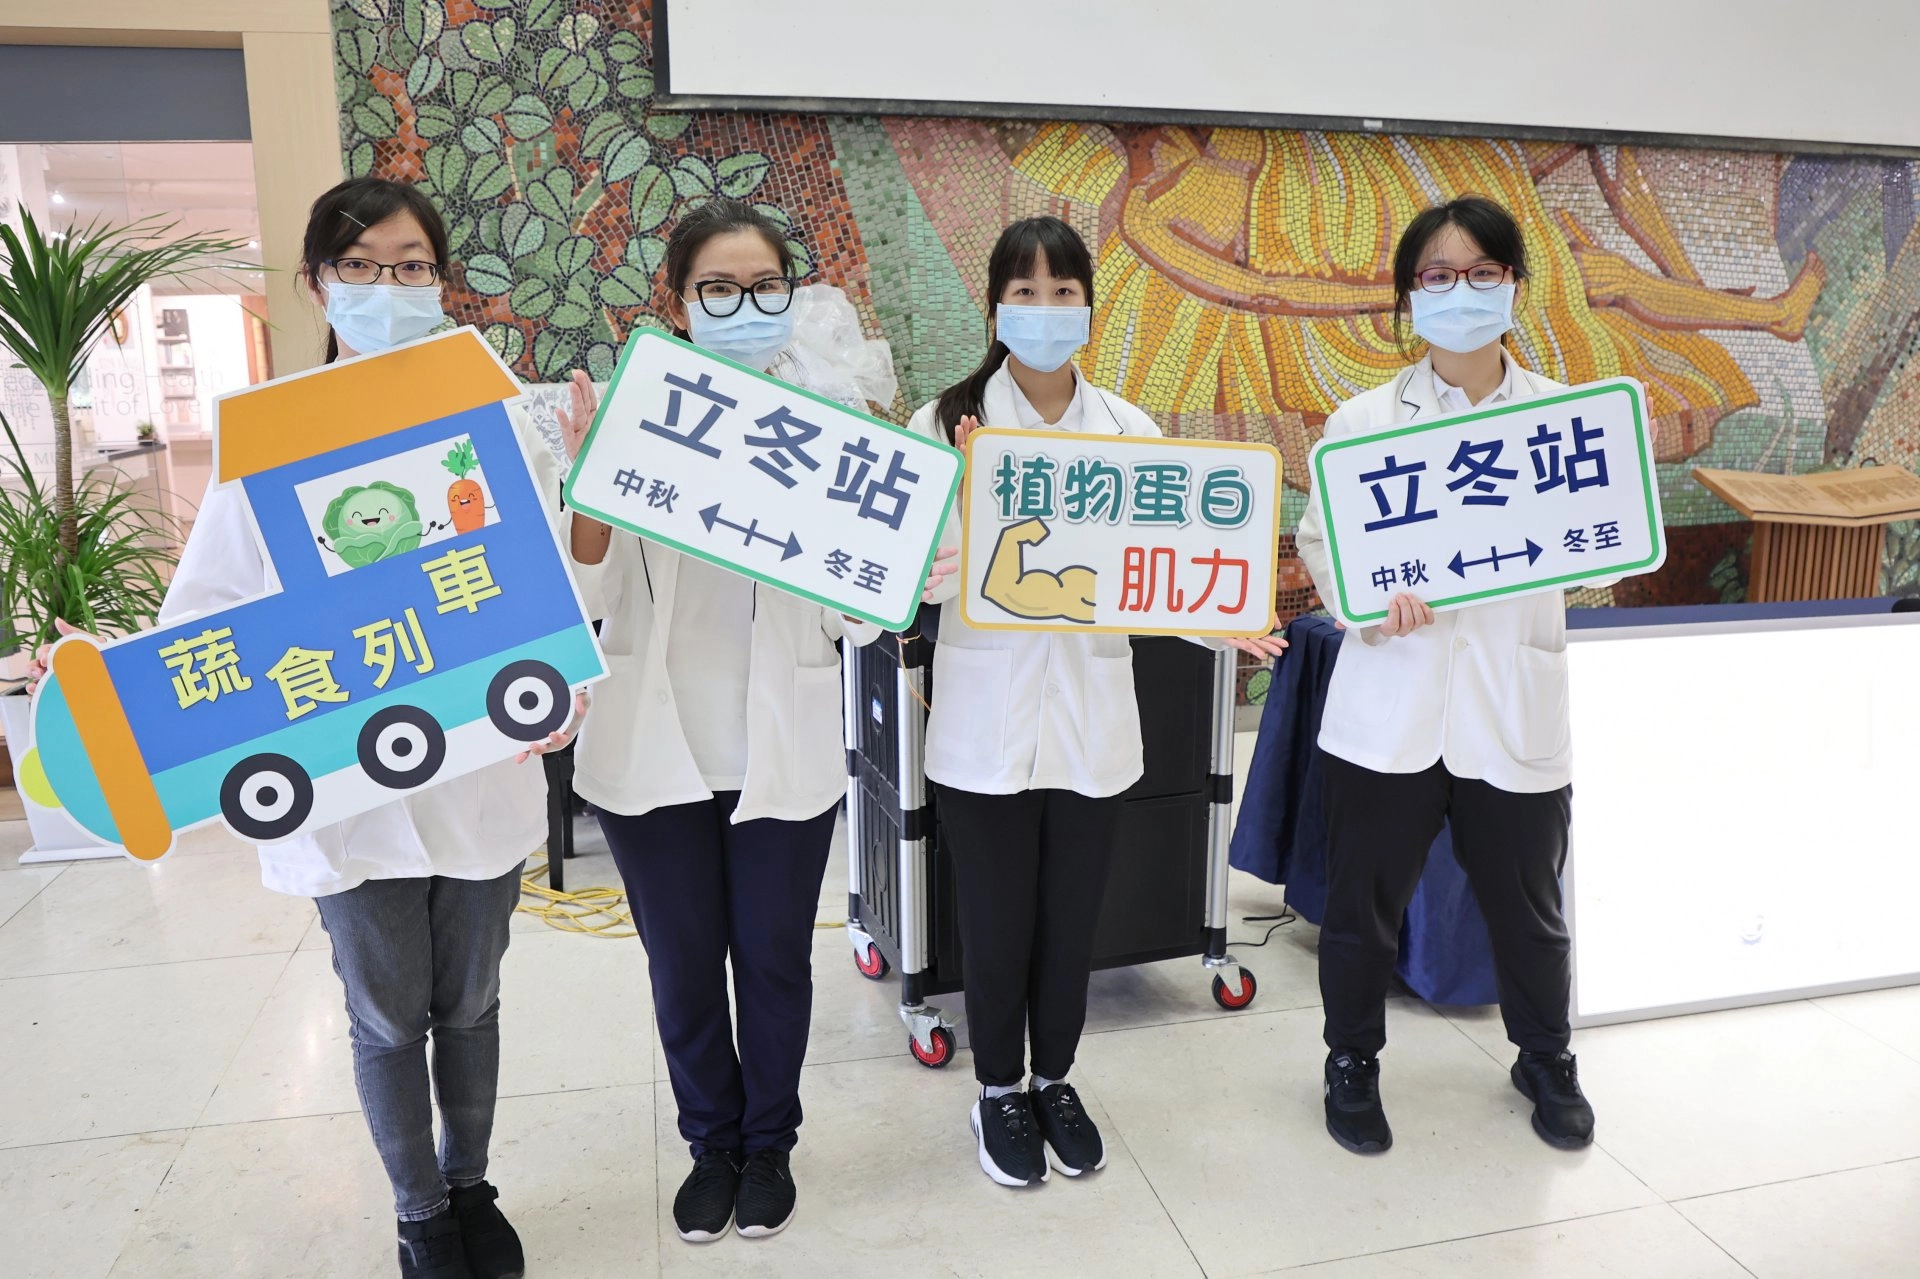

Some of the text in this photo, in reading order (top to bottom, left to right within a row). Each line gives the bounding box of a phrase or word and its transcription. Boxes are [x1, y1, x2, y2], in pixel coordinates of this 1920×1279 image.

[639, 372, 920, 531] 立冬站
[1359, 416, 1610, 533] 立冬站
[612, 468, 680, 514] 中秋
[992, 452, 1252, 528] 植物蛋白
[1563, 520, 1622, 553] 冬至
[824, 548, 889, 594] 冬至
[1118, 546, 1249, 614] 肌力
[1371, 559, 1430, 592] 中秋
[157, 543, 502, 721] 蔬食列車
